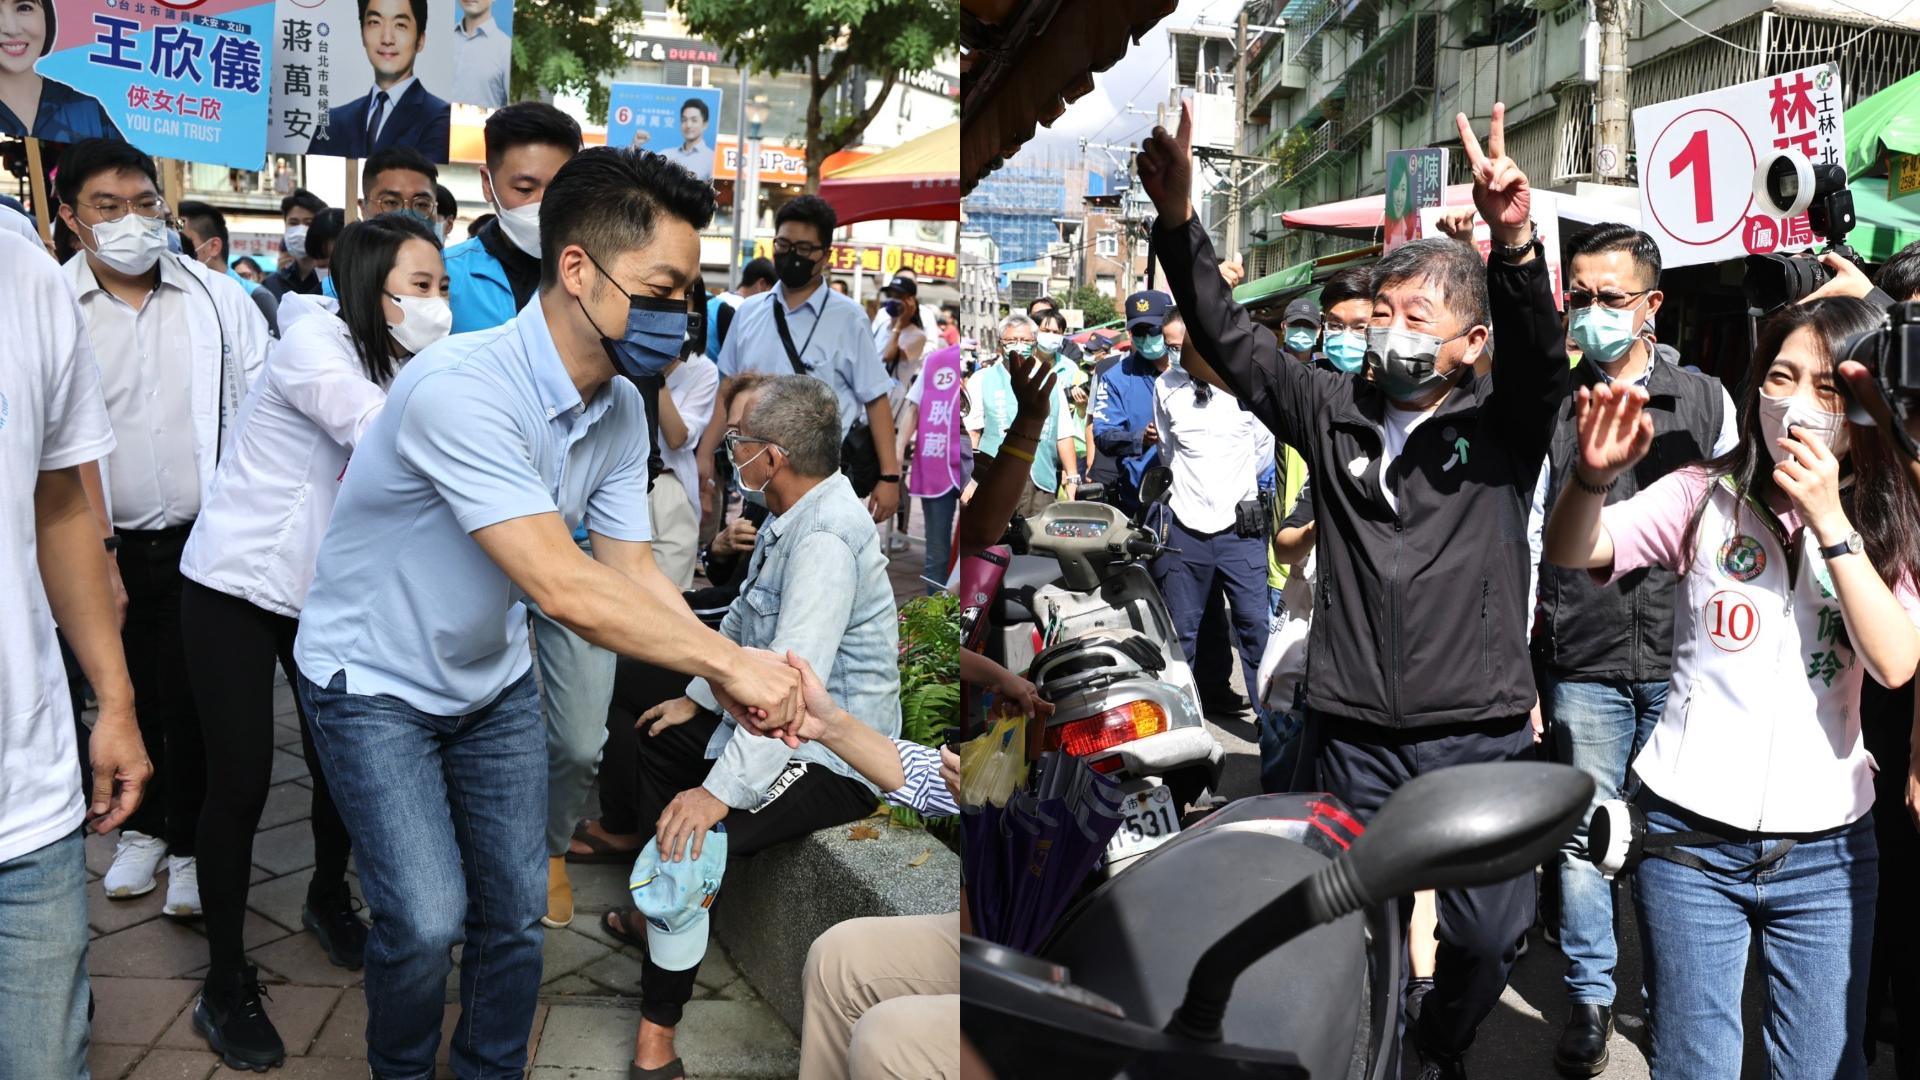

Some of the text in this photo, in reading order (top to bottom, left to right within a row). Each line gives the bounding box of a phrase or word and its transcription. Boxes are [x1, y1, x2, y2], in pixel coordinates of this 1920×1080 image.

[119, 0, 191, 22] 台北市議員
[90, 15, 261, 93] 王欣儀
[669, 48, 717, 62] DURAN
[282, 18, 312, 140] 蔣萬安
[317, 40, 330, 140] 台北市長候選人
[127, 85, 222, 120] 俠女仁欣
[619, 108, 628, 122] 6
[126, 113, 222, 143] YOU CAN TRUST
[1669, 129, 1714, 224] 1
[937, 372, 953, 385] 25
[921, 400, 951, 458] 耿葳
[1711, 600, 1754, 641] 10
